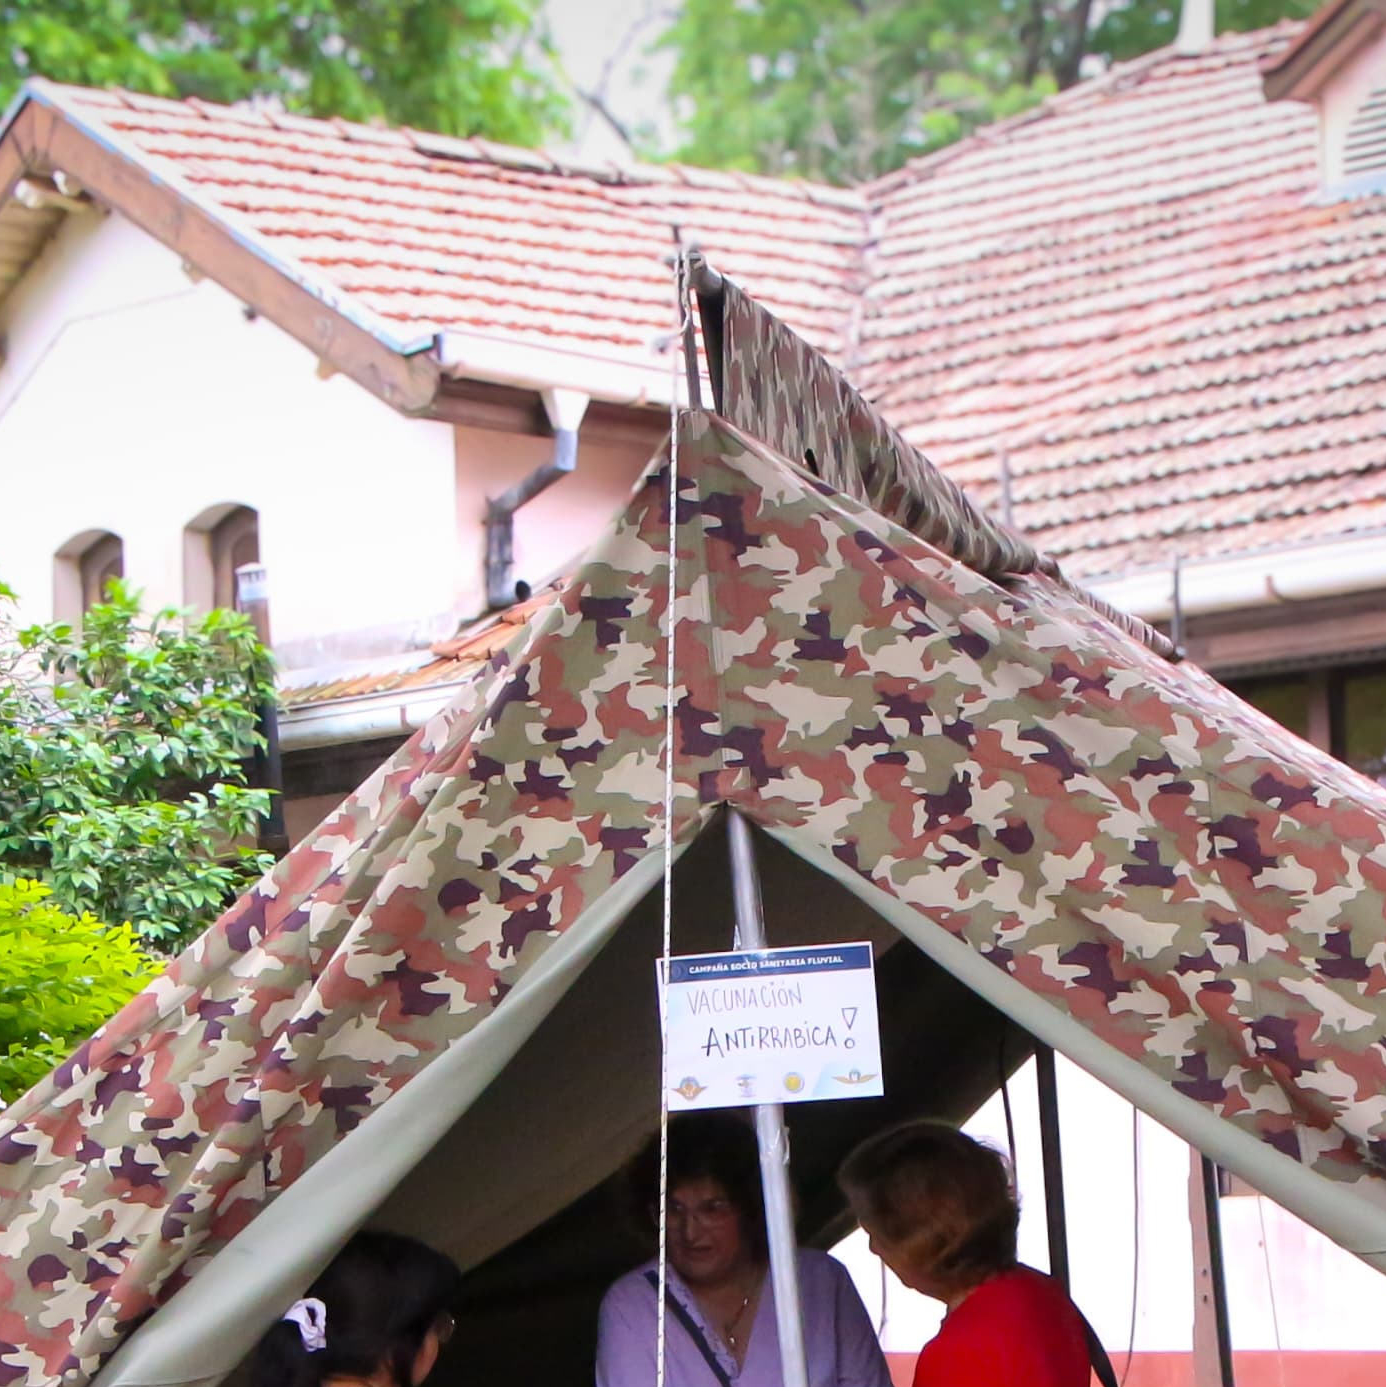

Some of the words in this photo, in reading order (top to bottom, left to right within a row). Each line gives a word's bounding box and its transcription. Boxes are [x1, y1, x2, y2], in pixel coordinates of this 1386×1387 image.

[688, 960, 729, 975] CAMPAÑA
[730, 957, 758, 972] SOCIO
[807, 954, 844, 967] FLUVIAL
